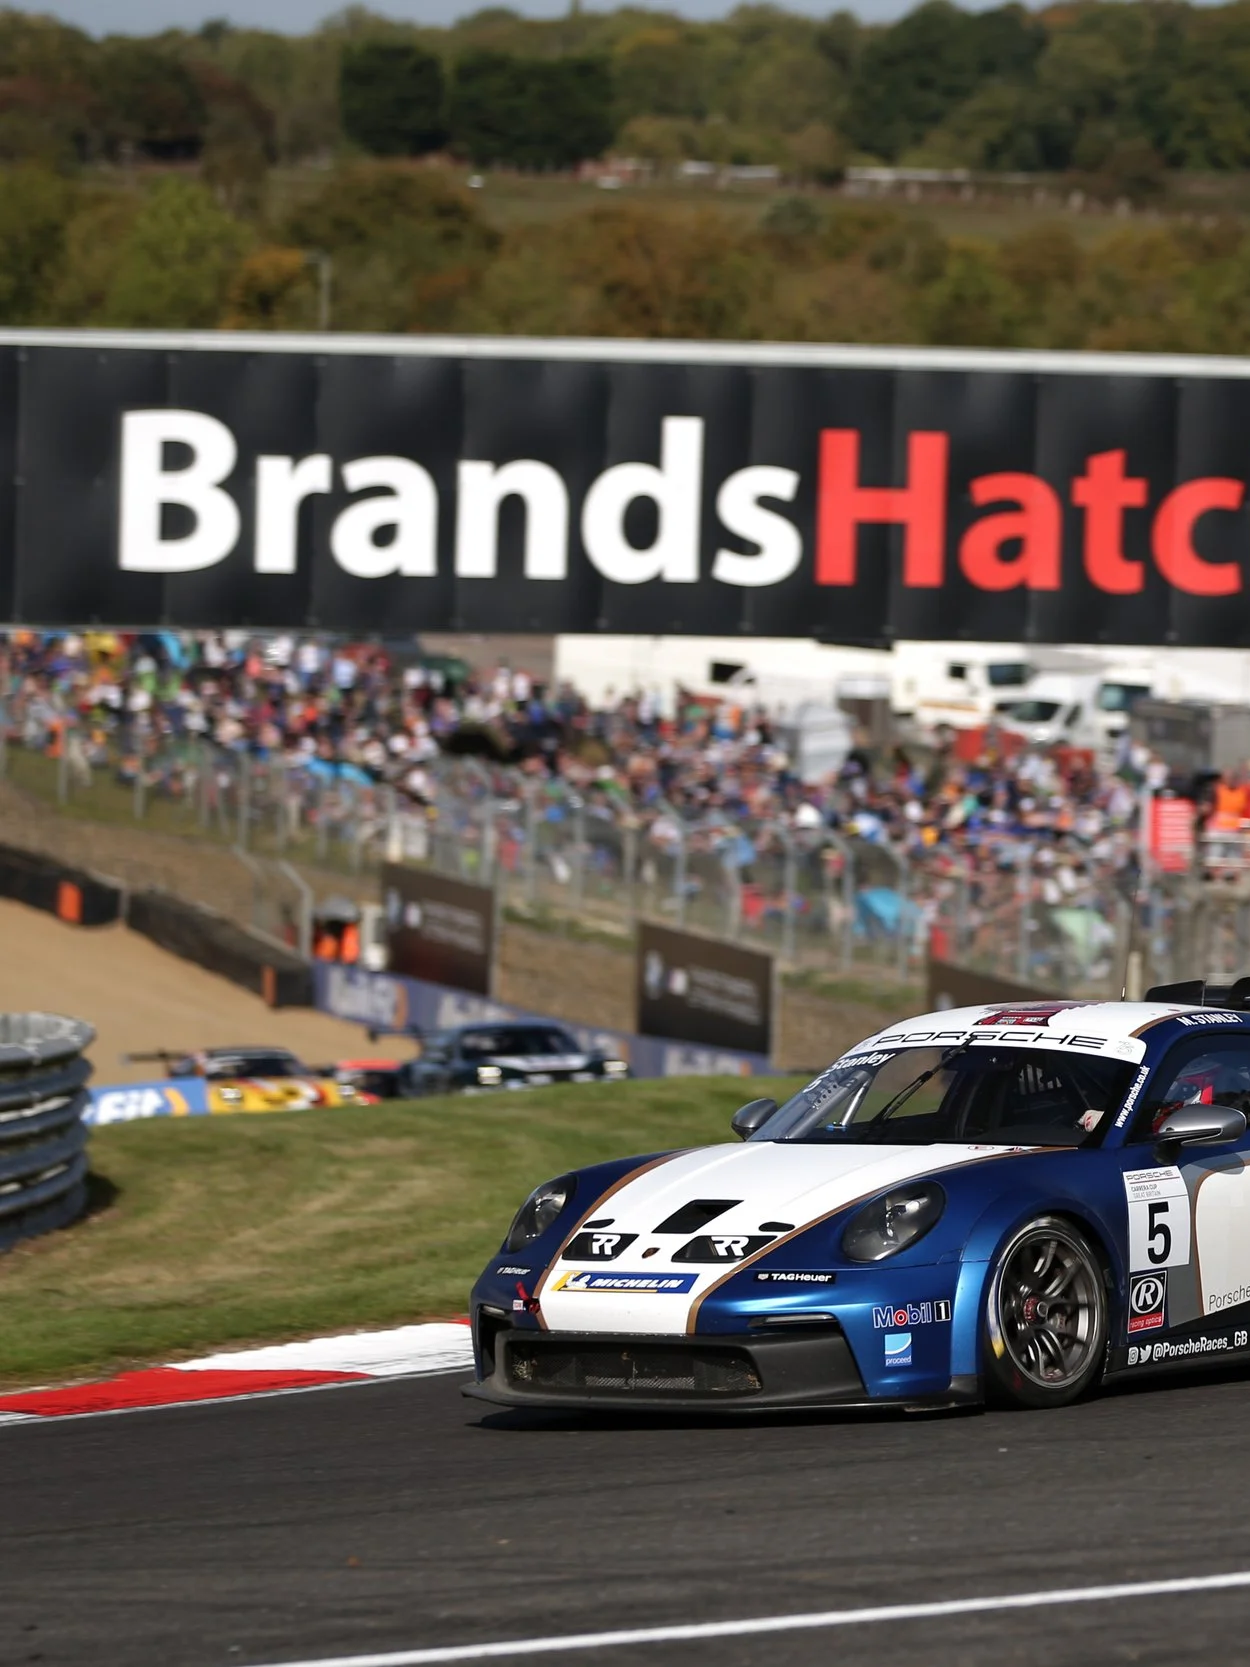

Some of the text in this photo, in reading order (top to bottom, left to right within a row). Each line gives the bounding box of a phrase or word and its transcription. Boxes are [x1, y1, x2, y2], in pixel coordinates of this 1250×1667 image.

[1191, 1013, 1243, 1025] STANLEY
[872, 1030, 1108, 1049] PORSCHE
[1114, 1065, 1151, 1128] www.porsche.co.uk
[1126, 1170, 1174, 1181] PORSCHE
[1147, 1201, 1172, 1265] 5
[591, 1278, 685, 1289] MICHELIN
[872, 1302, 932, 1329] Mobil
[1130, 1316, 1162, 1330] racing optics
[1152, 1330, 1248, 1362] @PorscheRaces_GB
[885, 1355, 912, 1367] proceed
